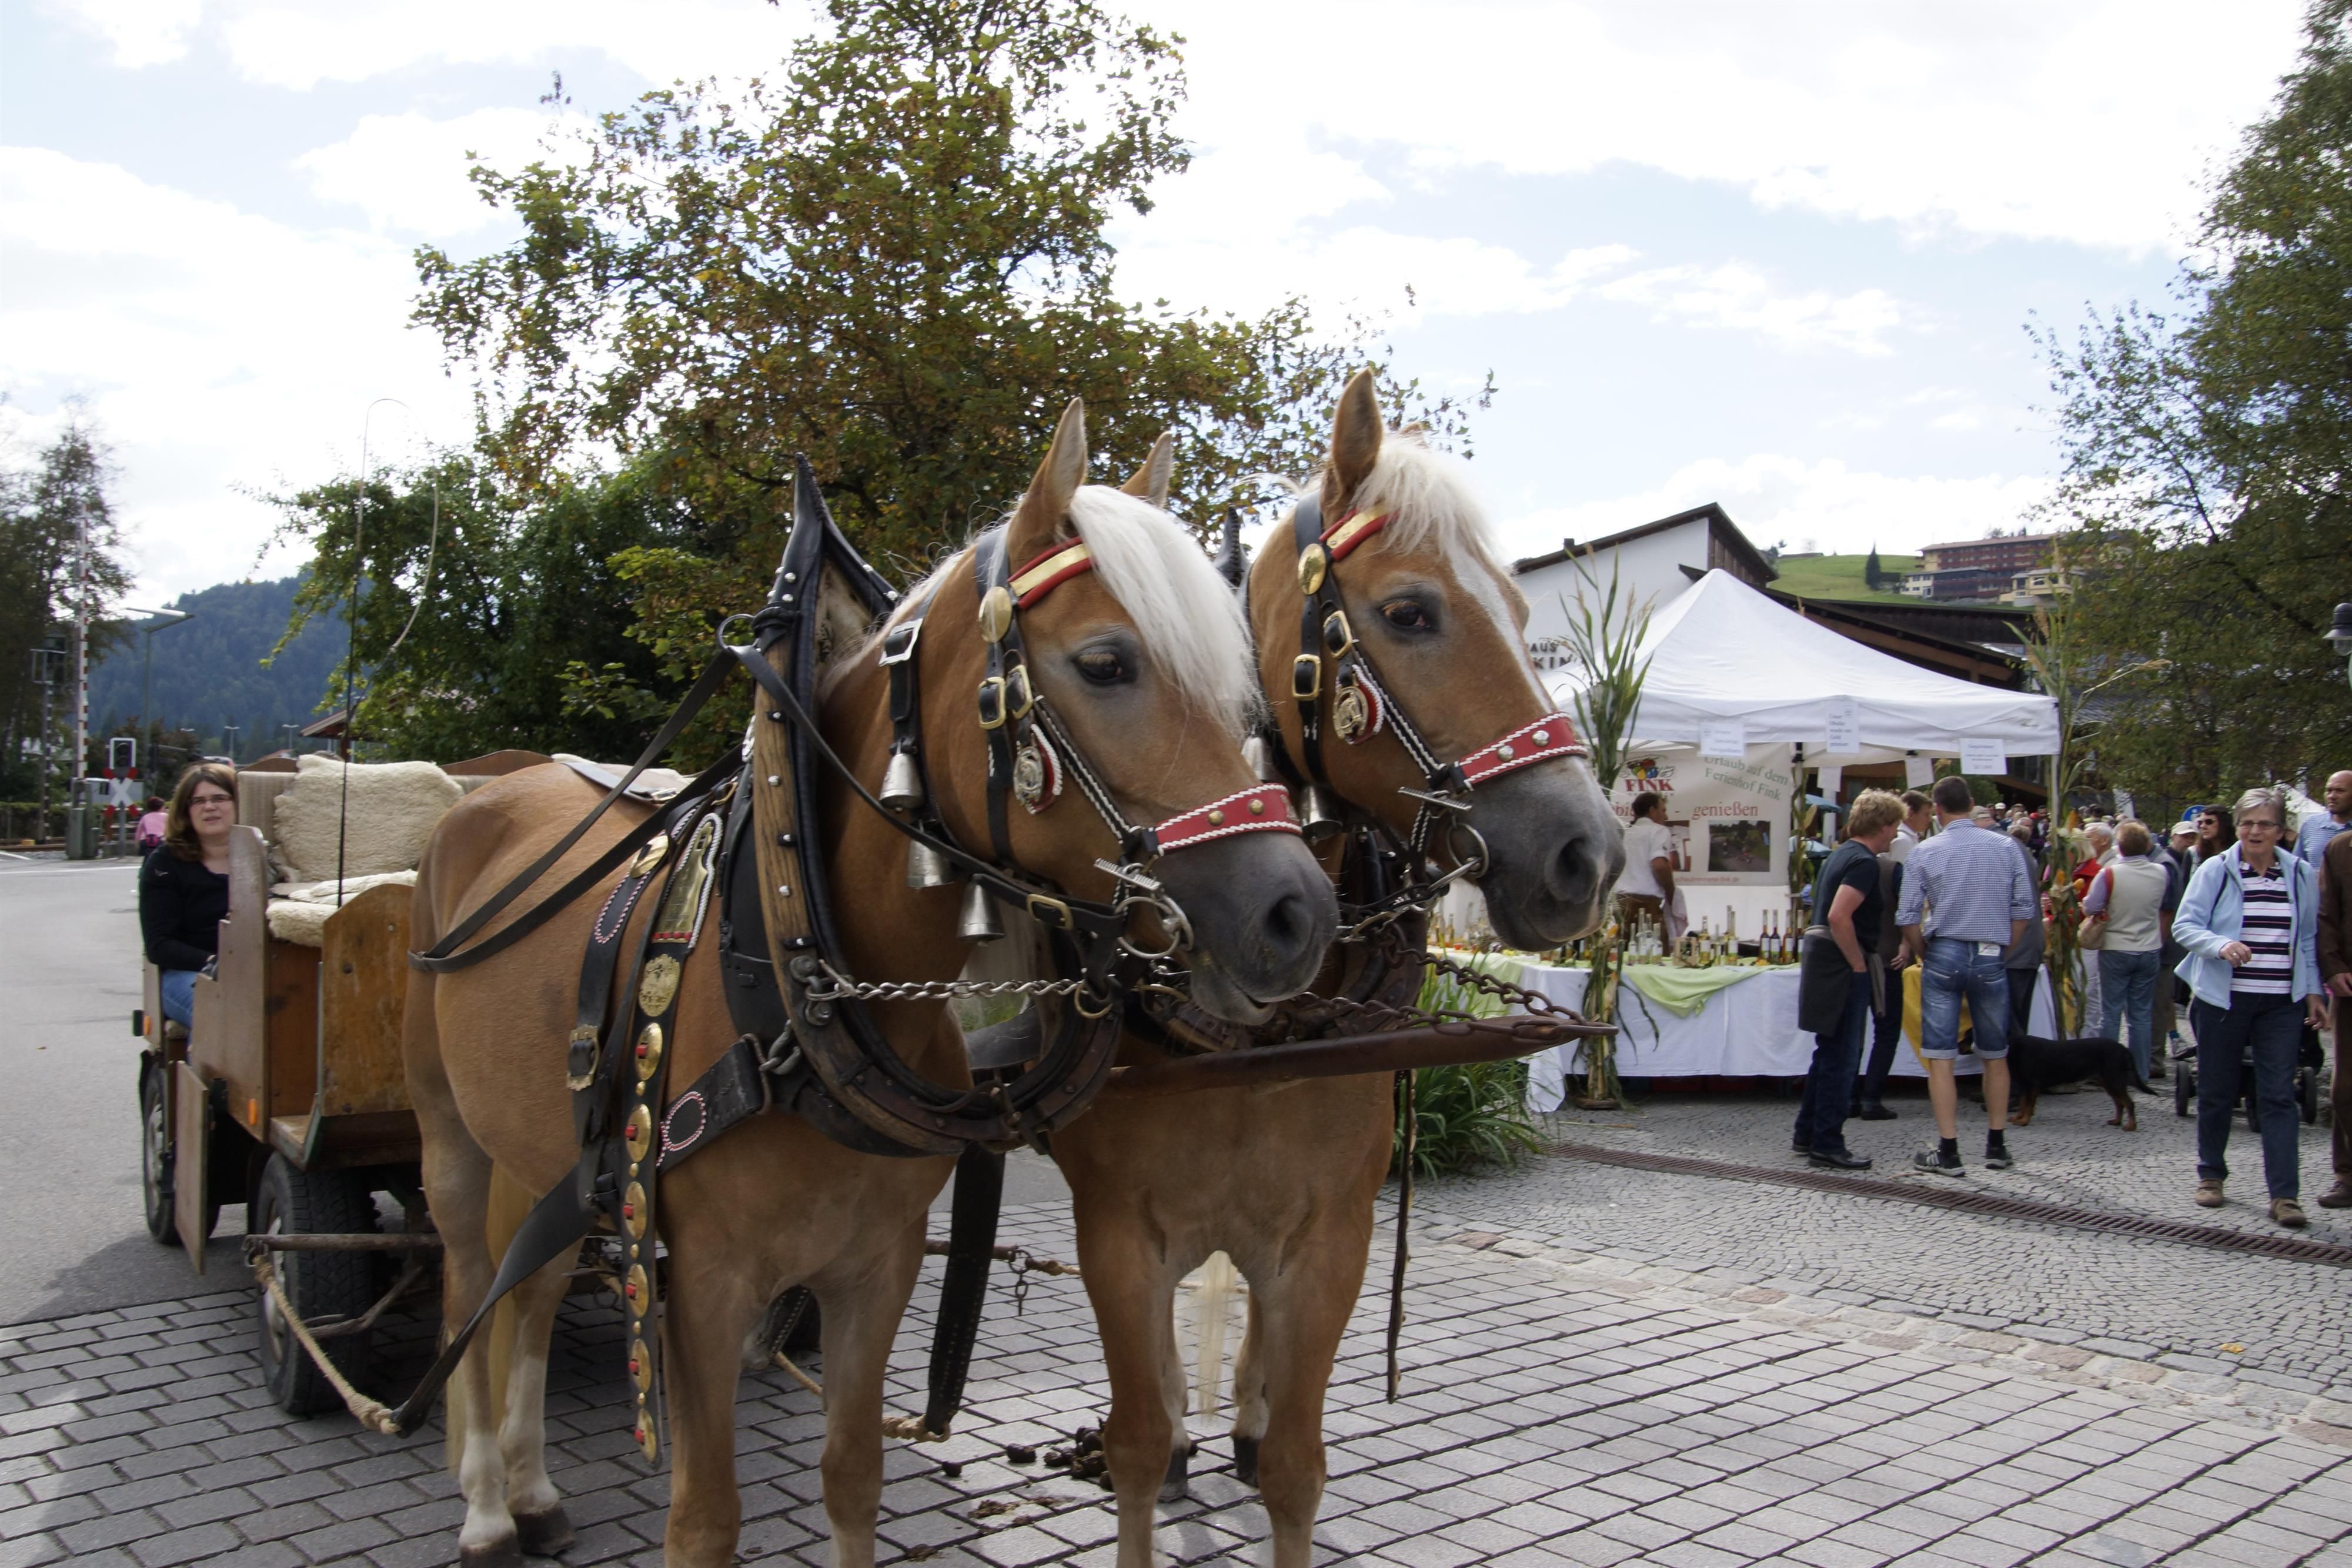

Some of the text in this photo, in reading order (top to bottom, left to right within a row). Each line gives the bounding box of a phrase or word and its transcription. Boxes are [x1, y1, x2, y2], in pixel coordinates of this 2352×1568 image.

[1526, 643, 1558, 652] AUS
[1705, 757, 1789, 785] Urlaub auf dem
[1625, 779, 1675, 791] FINK
[1705, 768, 1782, 800] Ferienhof Fink
[1692, 801, 1759, 820] genießen
